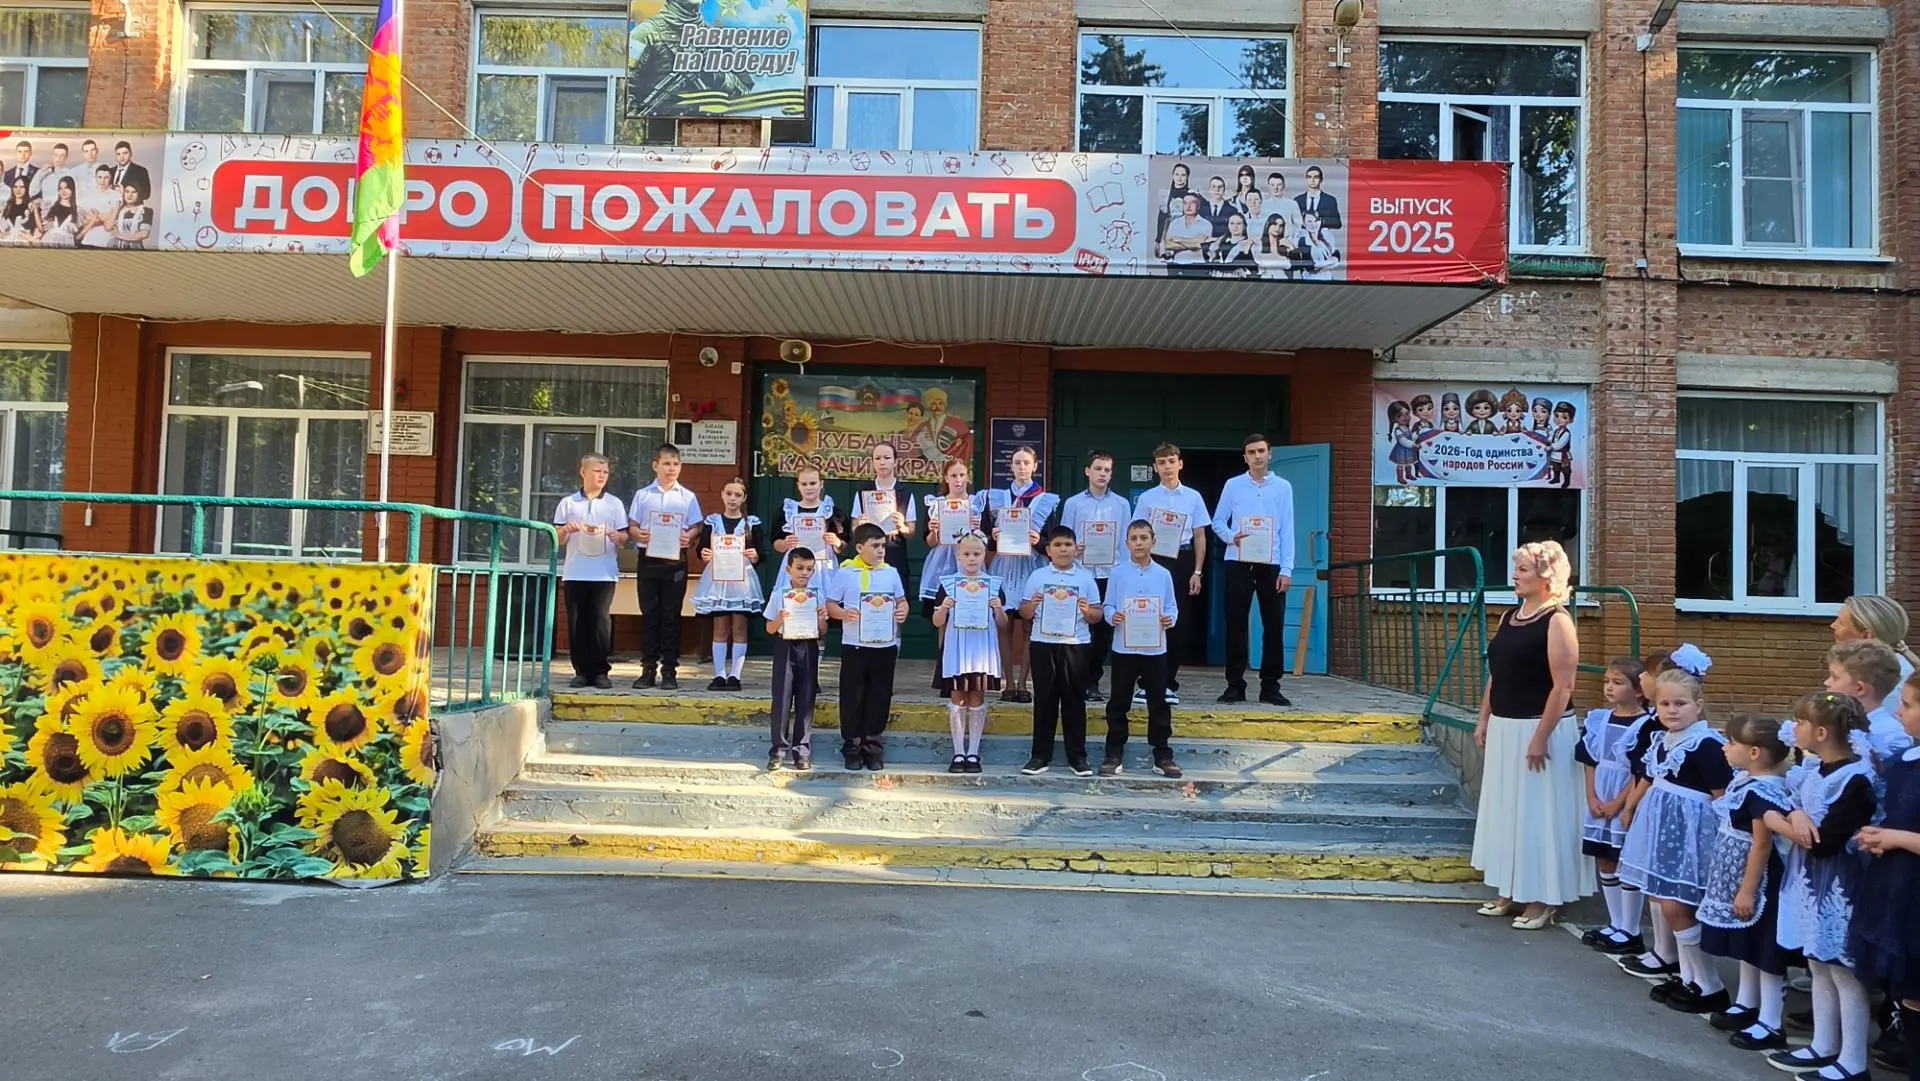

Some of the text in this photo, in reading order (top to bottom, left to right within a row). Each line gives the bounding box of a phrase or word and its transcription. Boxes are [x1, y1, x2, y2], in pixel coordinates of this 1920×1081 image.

[680, 24, 792, 47] Равнение
[673, 50, 798, 75] на Победу!
[234, 174, 1056, 239] ДОРО ПОЖАЛОВАТЬ
[1370, 198, 1453, 215] ВЫПУСК
[1368, 221, 1455, 254] 2025
[1434, 444, 1533, 459] 2026-Год единства
[778, 453, 878, 474] КАЗАЧИ
[1442, 459, 1524, 471] народов России
